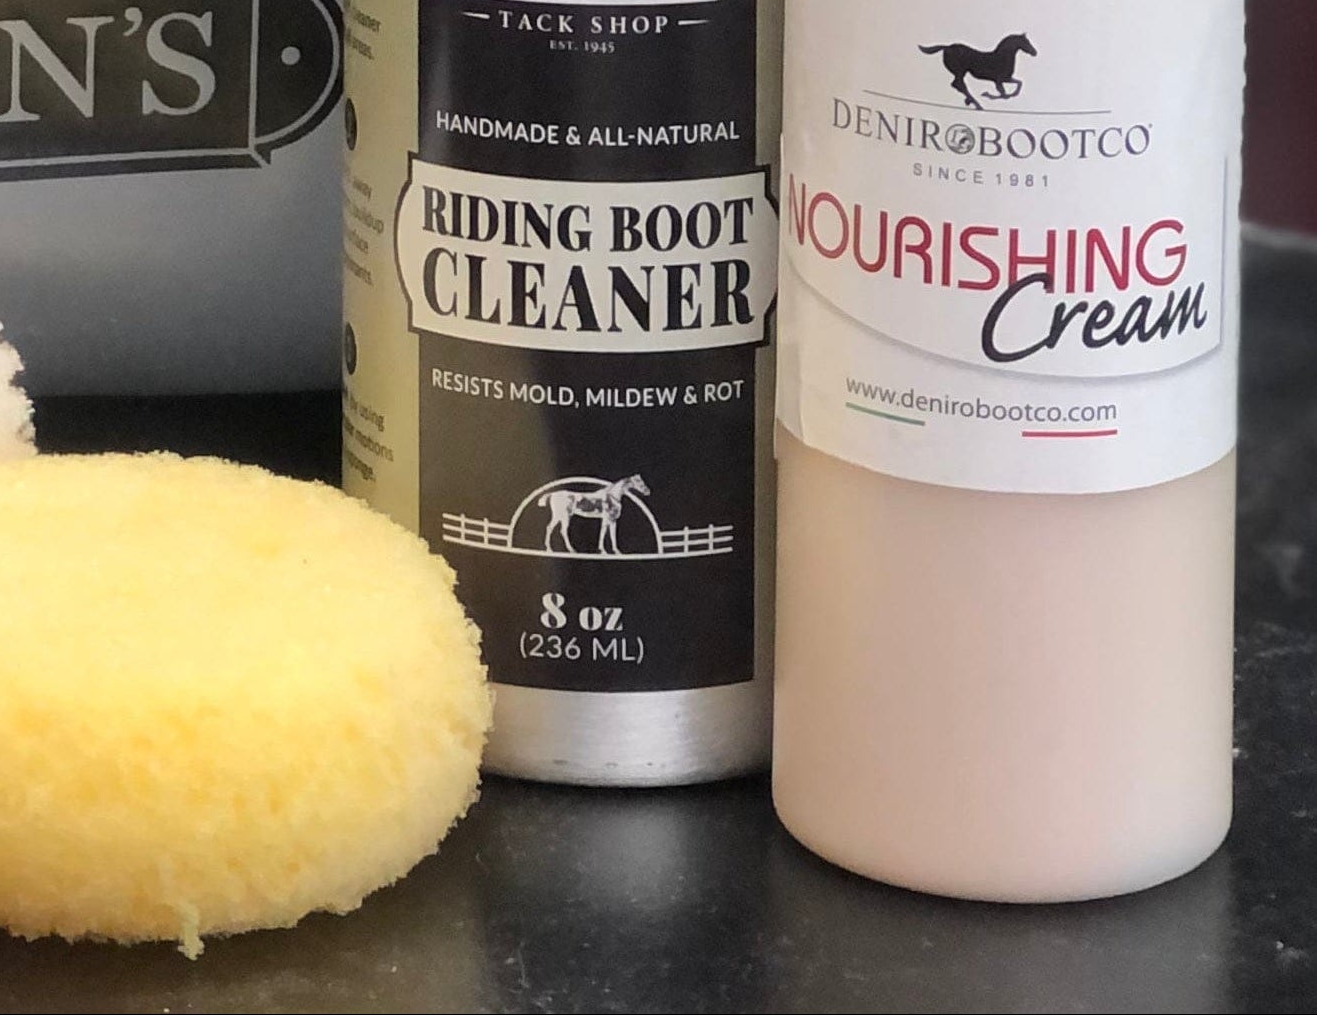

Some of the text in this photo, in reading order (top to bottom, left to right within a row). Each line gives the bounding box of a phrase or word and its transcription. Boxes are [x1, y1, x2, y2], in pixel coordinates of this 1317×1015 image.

[498, 10, 668, 34] TACK SHOP
[549, 39, 615, 54] EST. 1945
[436, 110, 739, 146] HANDMADE & ALL-NATURAL
[913, 162, 1049, 188] SINCE 1981
[422, 185, 591, 252] RIDING
[609, 196, 755, 252] BOOT
[788, 173, 1187, 294] NOURISHING
[423, 247, 755, 333] CLEANER
[981, 273, 1207, 362] Cream
[431, 368, 743, 409] RESISTS MOLD, MILDEW & ROT
[846, 377, 1117, 423] www.denirobootco.com
[540, 593, 623, 632] 8 oz
[520, 632, 644, 664] (236 ML)
